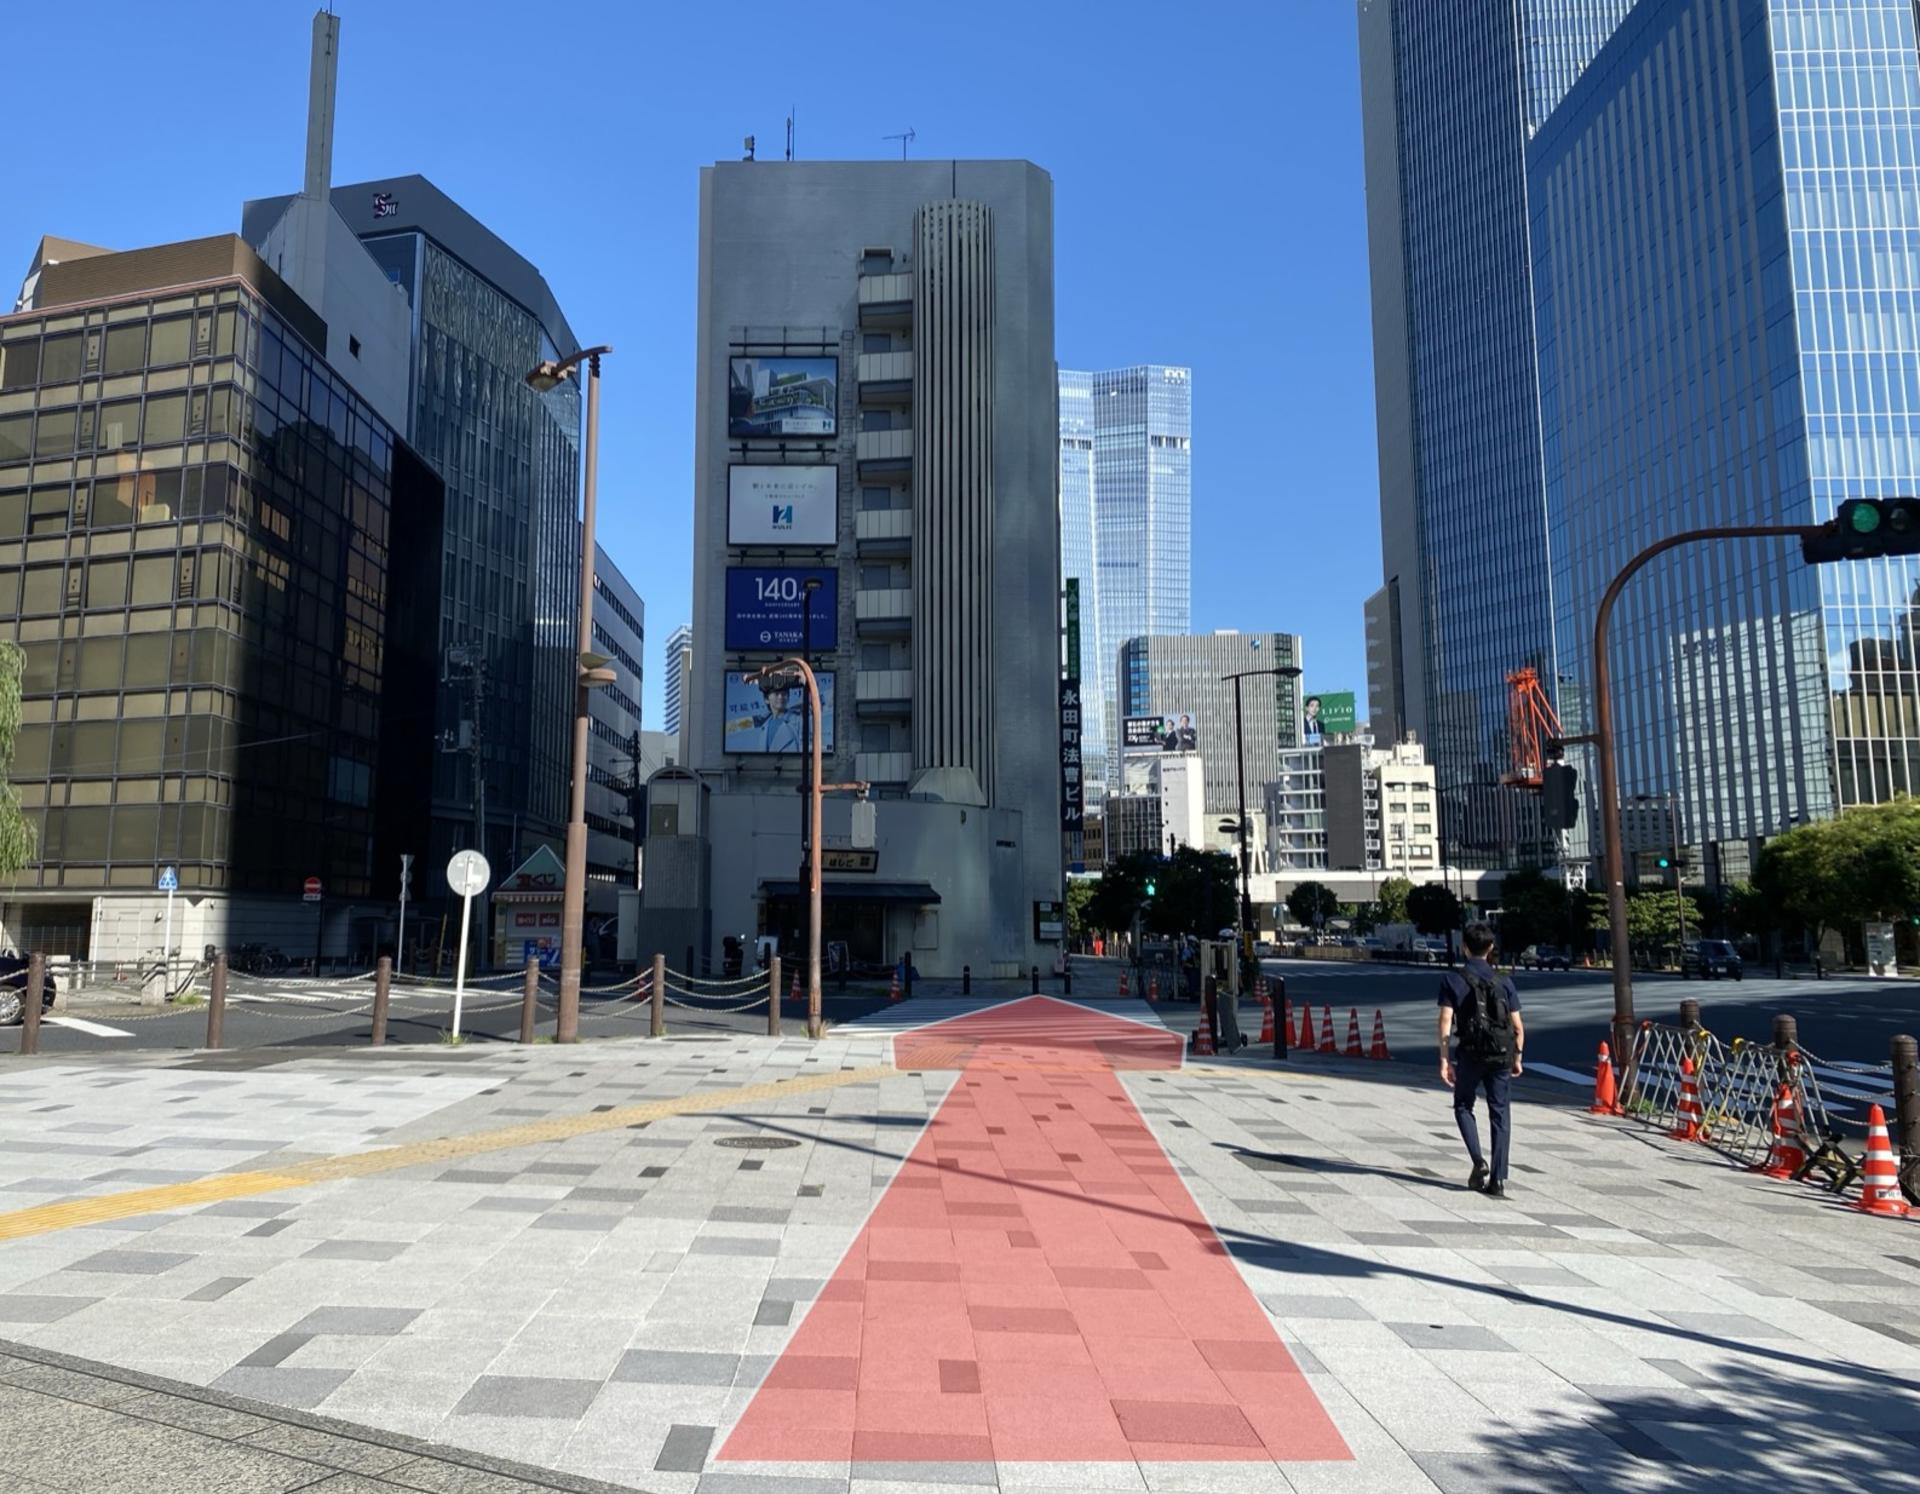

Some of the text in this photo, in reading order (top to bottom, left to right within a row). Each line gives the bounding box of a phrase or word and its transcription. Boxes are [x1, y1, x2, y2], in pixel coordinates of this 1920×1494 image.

[1062, 689, 1080, 822] 永田町法曹ビル
